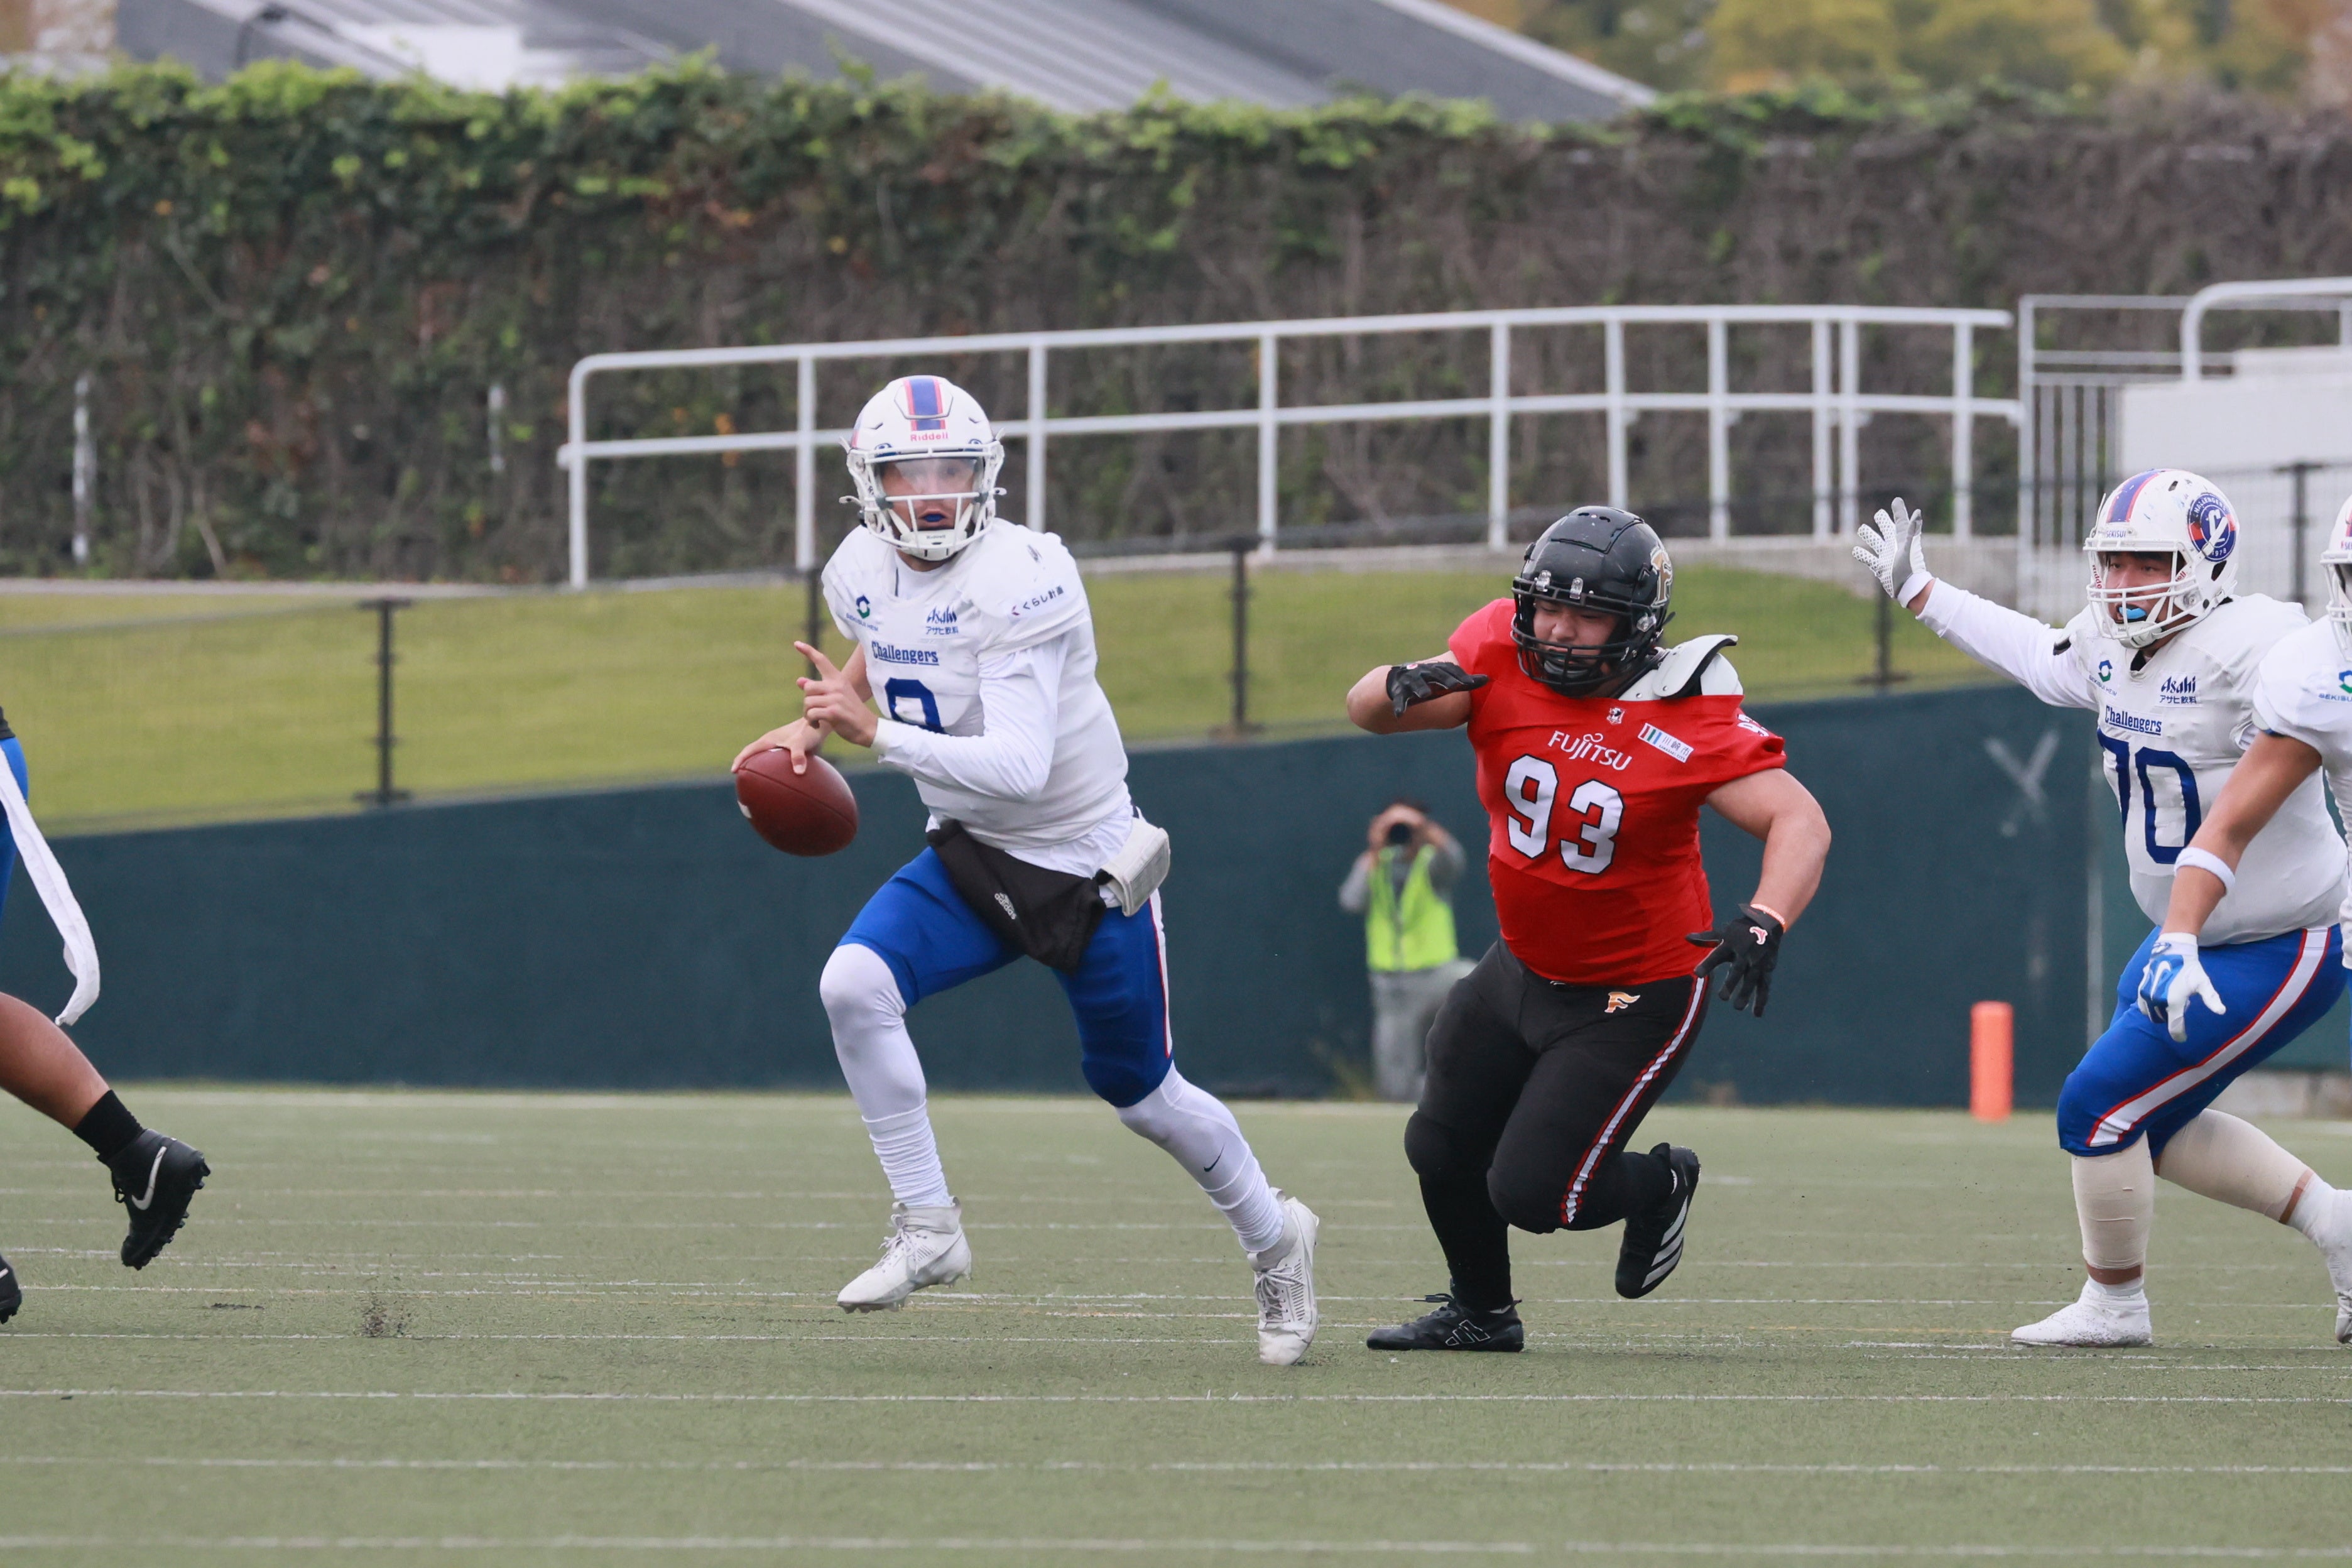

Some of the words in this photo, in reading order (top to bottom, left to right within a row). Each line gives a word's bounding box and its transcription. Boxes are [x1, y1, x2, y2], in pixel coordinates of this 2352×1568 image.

[910, 432, 948, 442] Riddell
[927, 605, 957, 624] Asahi
[871, 640, 939, 666] Challengers
[2161, 675, 2196, 694] Asahi
[2159, 695, 2197, 704] アサヒ飲料
[2105, 705, 2162, 736] Challengers
[1547, 730, 1633, 771] FUJITSU
[2097, 729, 2202, 864] 70
[1504, 753, 1625, 875] 93
[994, 893, 1016, 920] adidas
